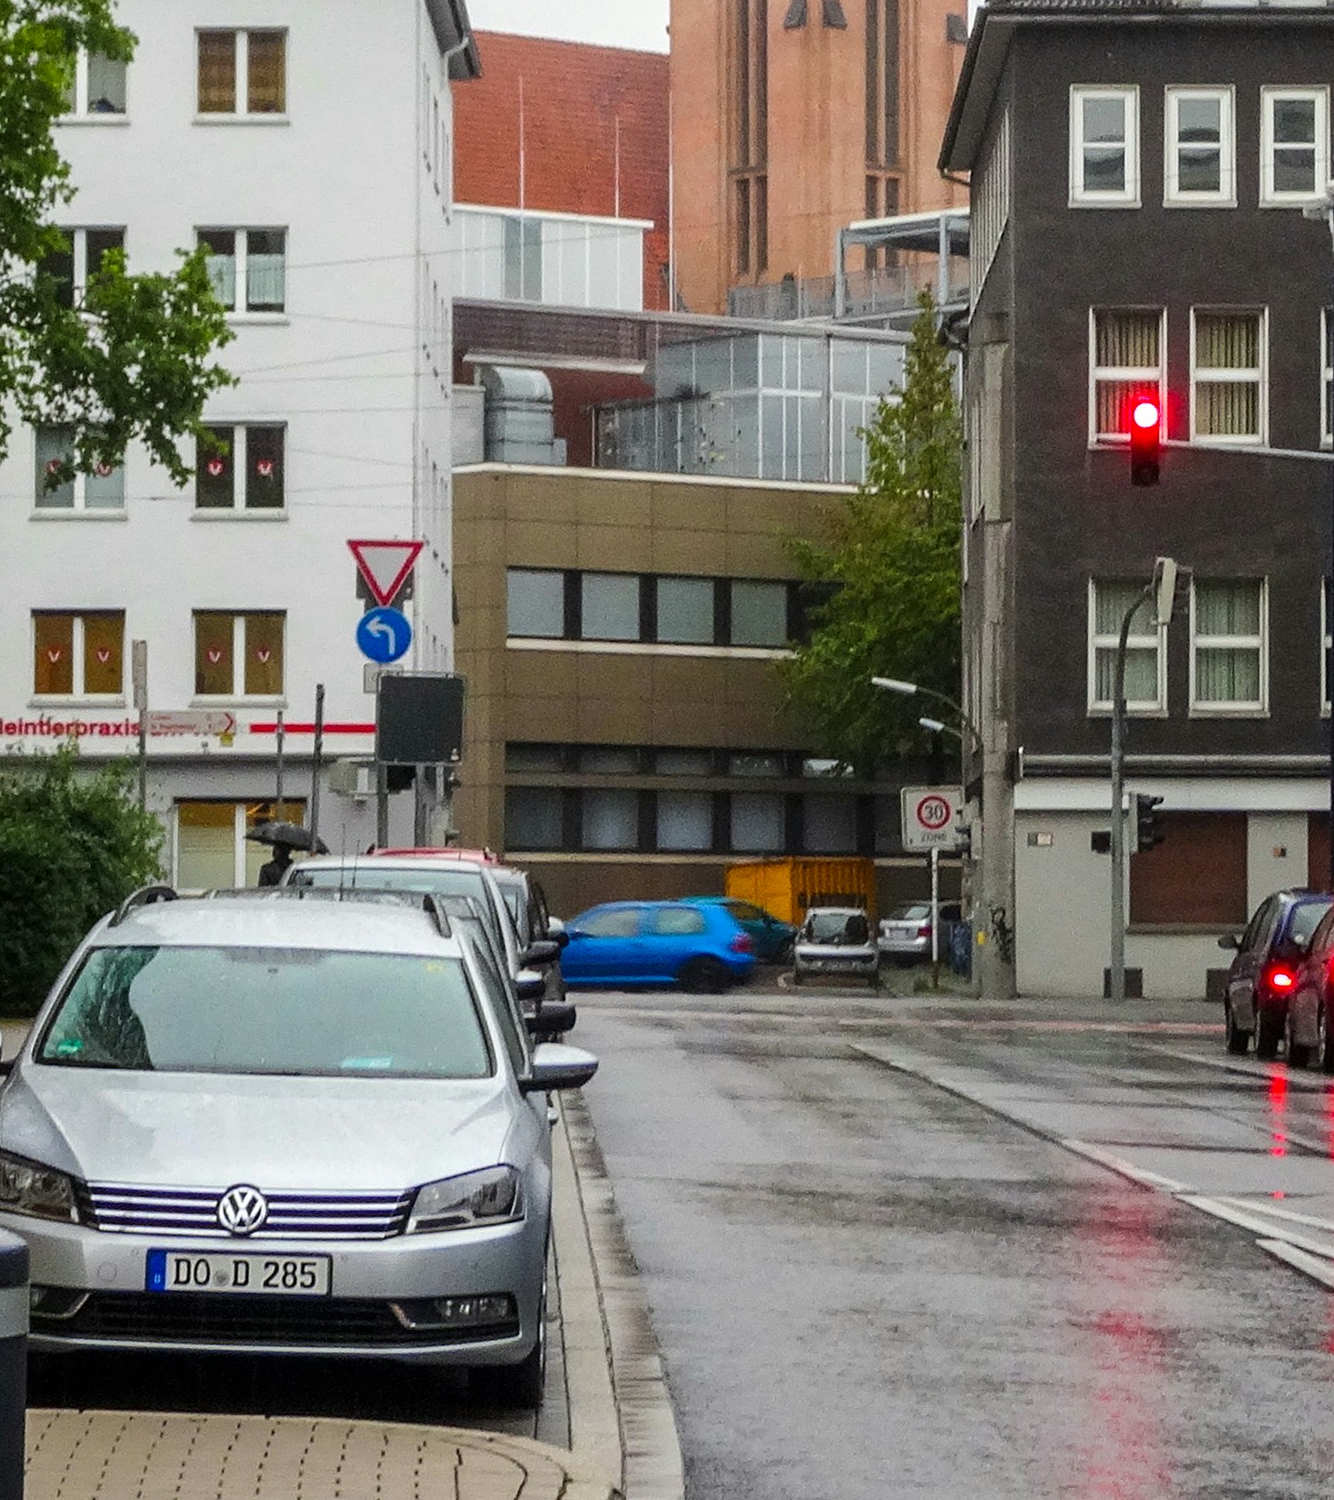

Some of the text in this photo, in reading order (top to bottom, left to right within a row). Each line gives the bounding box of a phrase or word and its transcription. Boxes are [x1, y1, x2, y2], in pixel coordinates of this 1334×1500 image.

[924, 804, 943, 820] 30
[174, 1258, 317, 1289] DO D 285
